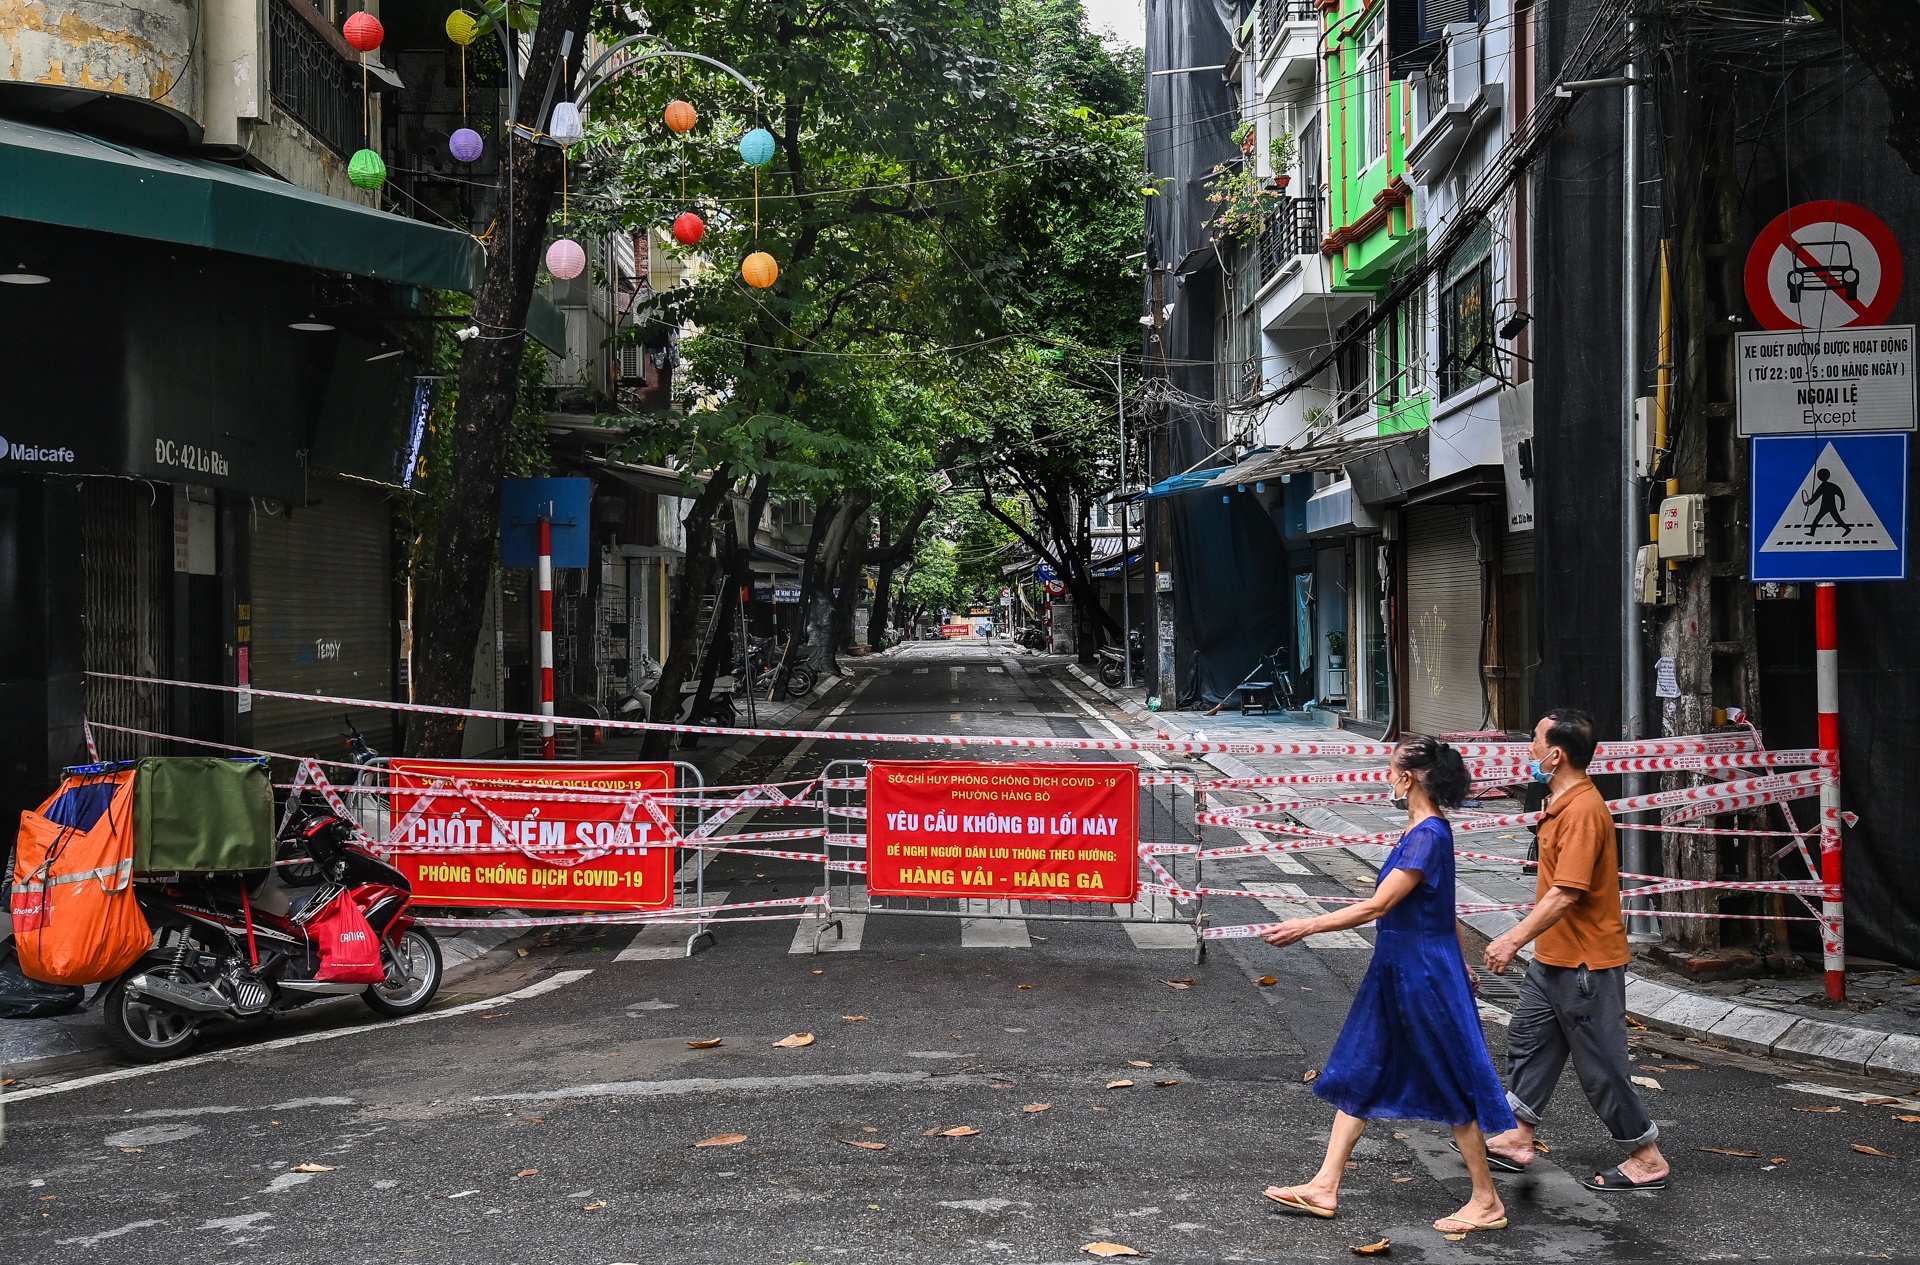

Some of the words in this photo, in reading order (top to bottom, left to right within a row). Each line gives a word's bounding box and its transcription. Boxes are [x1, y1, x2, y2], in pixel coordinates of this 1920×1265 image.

[1745, 345, 1757, 358] XE
[1761, 342, 1784, 358] QUÉT
[1787, 340, 1820, 356] ĐƯỜNG
[1824, 340, 1849, 357] ĐƯỢC
[1853, 340, 1878, 356] HOẠT
[1881, 337, 1908, 353] ĐỘNG
[1842, 360, 1868, 377] HÀNG
[1872, 360, 1898, 376] NGÀY
[1797, 387, 1838, 407] NGOẠI
[1843, 384, 1858, 406] LỆ
[1803, 409, 1857, 426] Except
[10, 443, 75, 462] Maicafe
[181, 444, 196, 470] 42
[591, 780, 642, 789] COVID-19
[888, 773, 905, 783] SỞ
[907, 773, 924, 784] CHỈ
[927, 775, 948, 784] HUY
[951, 773, 989, 785] PHÒNG
[1033, 777, 1058, 788] DỊCH
[1061, 777, 1094, 786] COVID
[1104, 778, 1116, 787] 19
[951, 789, 998, 800] PHƯỜNG
[1001, 790, 1032, 801] HÀNG
[408, 807, 482, 851] CHỐT
[886, 810, 918, 831] YÊU
[924, 809, 958, 832] CẦU
[963, 812, 1022, 834] KHÔNG
[1027, 817, 1044, 834] ĐI
[1051, 811, 1077, 835] LỐI
[1083, 814, 1118, 835] NÀY
[903, 846, 928, 859] NGHỊ
[931, 845, 962, 857] NGƯỜI
[965, 845, 986, 858] DÂN
[990, 848, 1009, 859] LƯU
[1012, 847, 1046, 860] THÔNG
[1049, 849, 1075, 860] THEO
[1078, 848, 1117, 862] HƯỚNG:
[419, 862, 471, 883] PHÒNG
[475, 862, 527, 885] CHỐNG
[532, 869, 568, 889] DỊCH
[573, 870, 643, 888] COVID-19
[900, 866, 954, 885] HÀNG
[961, 866, 993, 886] VẢI
[1014, 869, 1070, 888] HÀNG
[1077, 871, 1104, 889] GÀ
[340, 932, 366, 942] CANIFA
